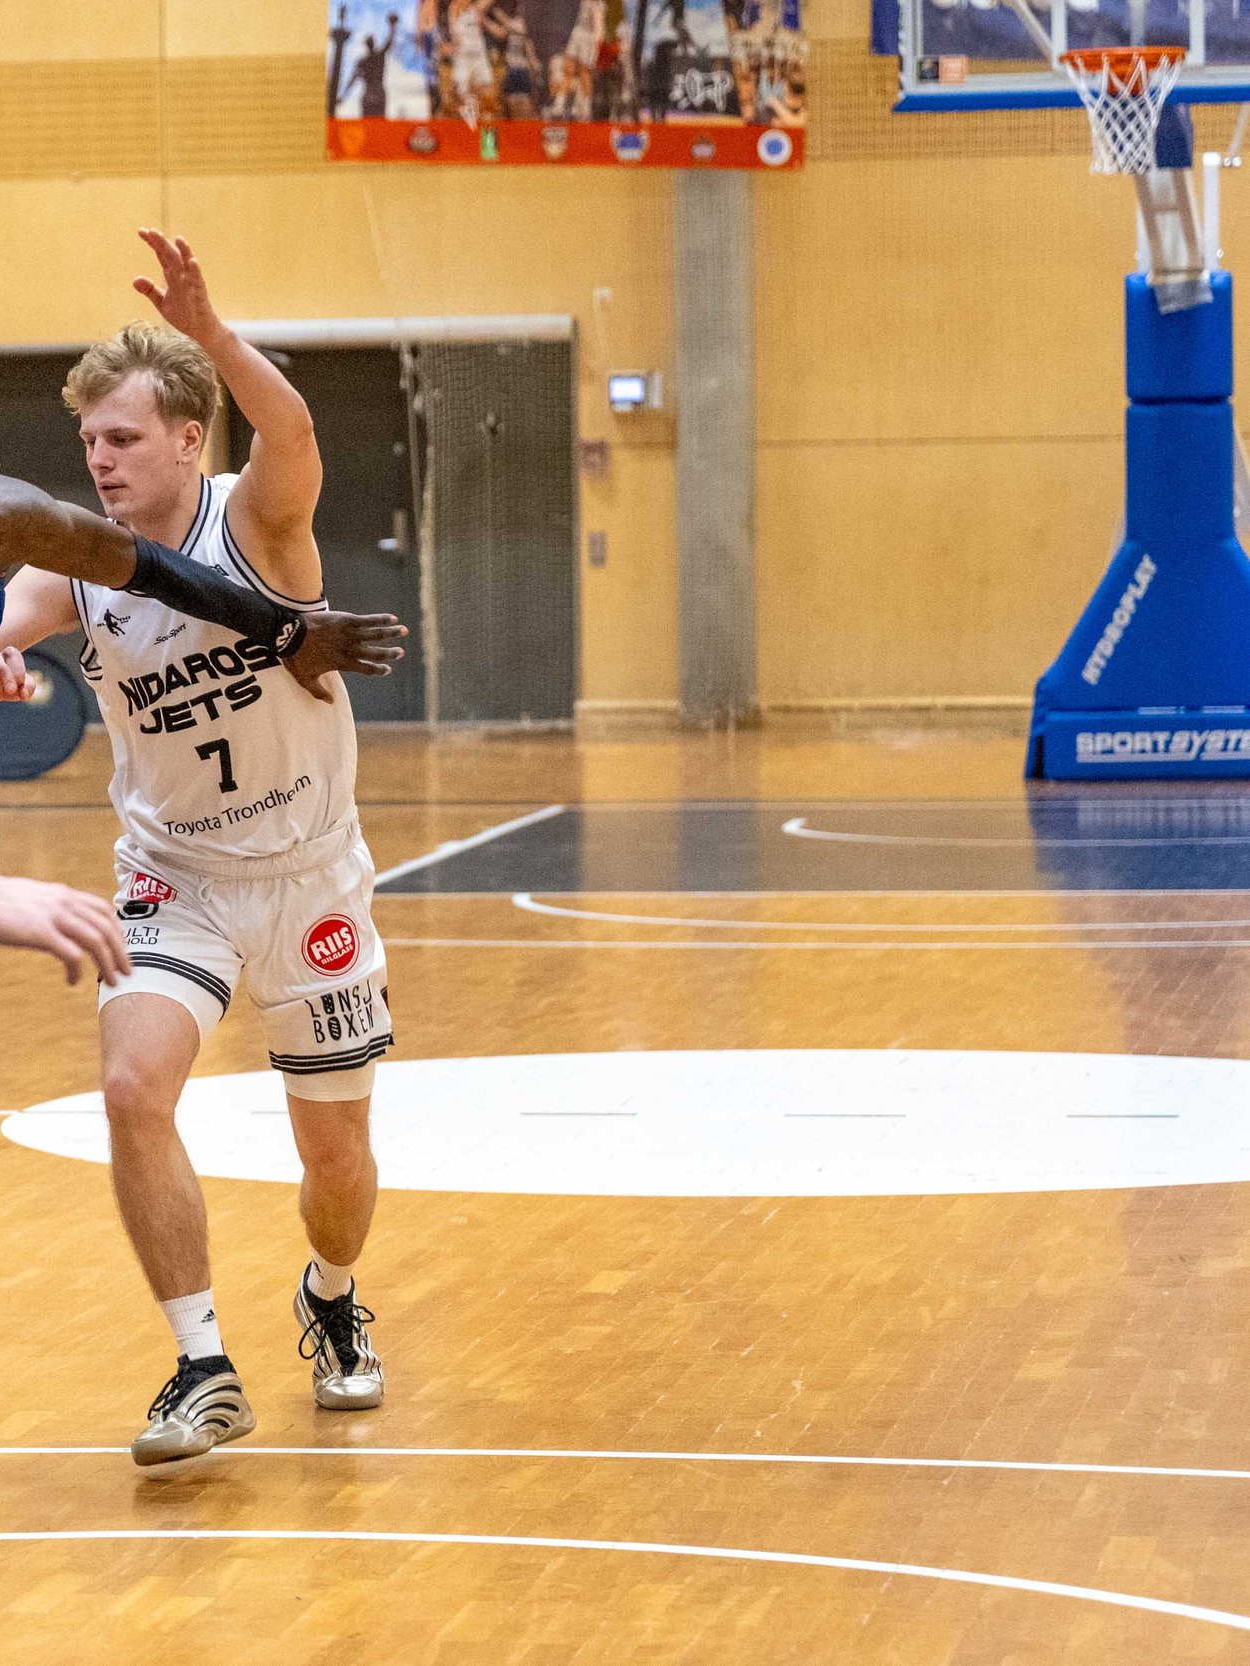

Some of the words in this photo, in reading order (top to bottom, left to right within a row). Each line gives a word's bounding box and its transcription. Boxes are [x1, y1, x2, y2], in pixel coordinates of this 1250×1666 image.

[118, 636, 282, 716] NIDAROS
[140, 674, 263, 734] JETS
[195, 737, 239, 794] 7
[163, 810, 223, 838] Toyota
[222, 774, 312, 826] Trondhem
[310, 926, 352, 960] RIIS
[313, 1003, 375, 1044] BOXEN
